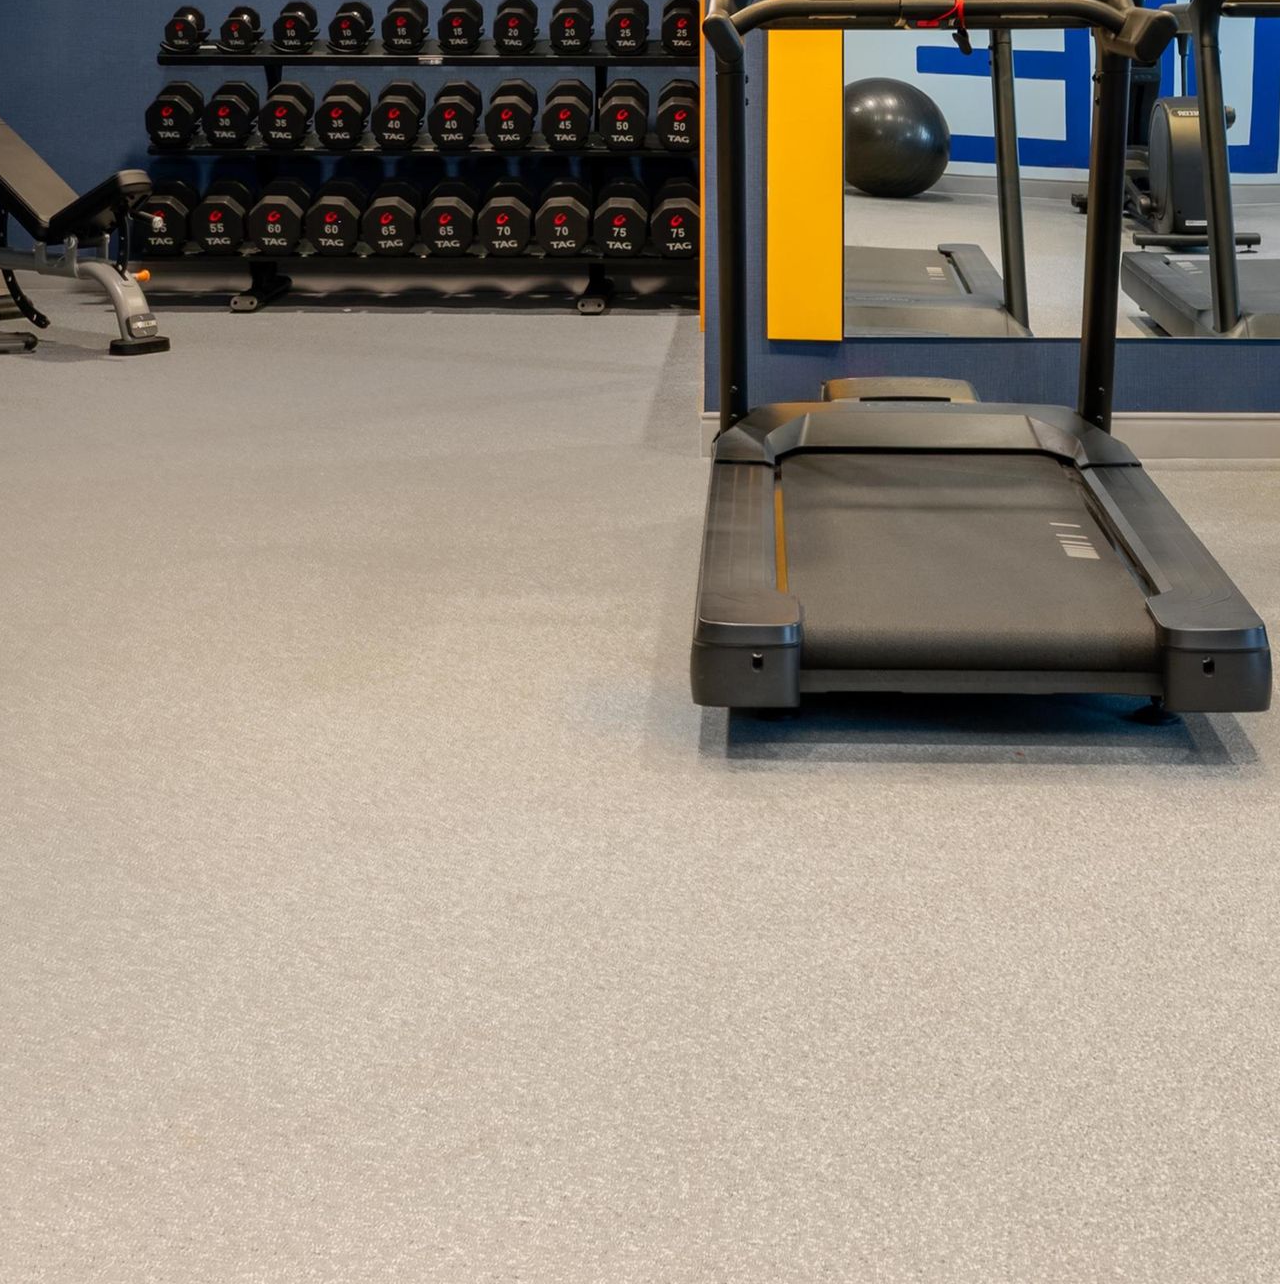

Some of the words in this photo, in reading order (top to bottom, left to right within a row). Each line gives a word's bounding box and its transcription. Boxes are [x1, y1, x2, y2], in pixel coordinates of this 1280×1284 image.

[286, 29, 296, 37] 10
[342, 29, 352, 37] 10
[396, 27, 407, 36] 15
[453, 27, 463, 36] 15
[507, 27, 519, 37] 20
[564, 28, 576, 37] 20
[620, 28, 632, 38] 25
[676, 28, 688, 37] 25
[448, 37, 469, 45] TAG
[503, 38, 523, 47] TAG
[560, 38, 581, 46] TAG
[615, 39, 636, 47] TAG
[671, 39, 692, 47] TAG
[162, 118, 174, 127] 30
[218, 117, 231, 127] 30
[275, 118, 287, 128] 35
[332, 119, 344, 128] 35
[387, 120, 401, 129] 40
[444, 119, 458, 129] 40
[501, 120, 515, 130] 45
[558, 120, 572, 130] 45
[616, 121, 629, 131] 50
[673, 121, 686, 132] 50
[213, 130, 237, 139] TAG
[269, 130, 292, 139] TAG
[327, 132, 350, 140] TAG
[382, 132, 405, 141] TAG
[440, 132, 464, 141] TAG
[497, 133, 521, 142] TAG
[554, 133, 577, 141] TAG
[611, 134, 634, 142] TAG
[667, 134, 690, 144] TAG
[209, 222, 225, 233] 55
[267, 223, 282, 234] 60
[324, 224, 339, 234] 60
[381, 225, 397, 236] 65
[439, 225, 454, 236] 65
[496, 226, 511, 236] 70
[554, 226, 569, 237] 70
[612, 227, 627, 238] 75
[670, 227, 686, 238] 75
[148, 237, 174, 246] TAG
[205, 237, 231, 246] TAG
[261, 237, 288, 246] TAG
[318, 238, 344, 247] TAG
[377, 239, 404, 249] TAG
[434, 239, 461, 248] TAG
[491, 239, 518, 249] TAG
[550, 239, 576, 249] TAG
[606, 240, 632, 250] TAG
[665, 241, 692, 251] TAG
